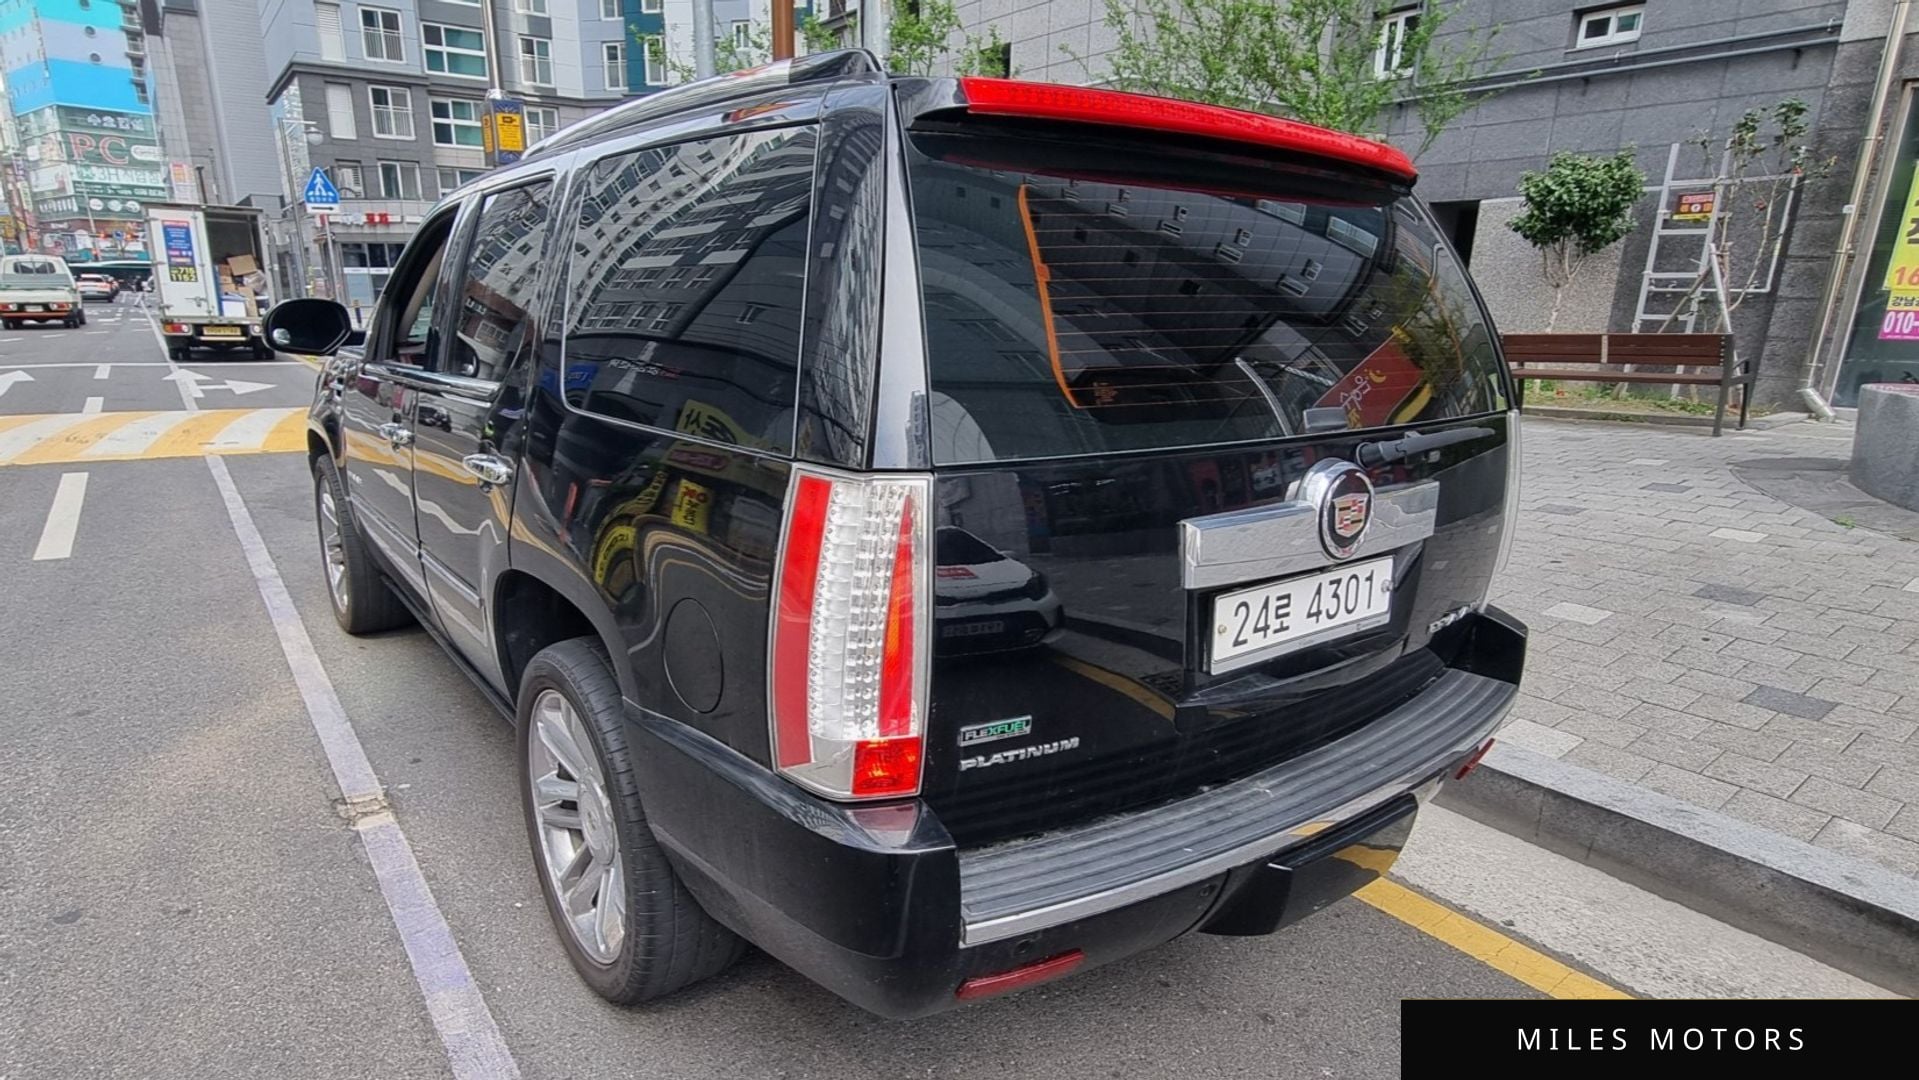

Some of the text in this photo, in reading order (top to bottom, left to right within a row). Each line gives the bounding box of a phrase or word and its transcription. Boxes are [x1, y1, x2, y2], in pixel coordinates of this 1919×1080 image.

[68, 132, 128, 164] PC
[1232, 593, 1292, 648] 24로
[1306, 569, 1375, 624] 4301
[964, 720, 1030, 741] FLEXFUEL
[959, 736, 1080, 772] PLATINUM
